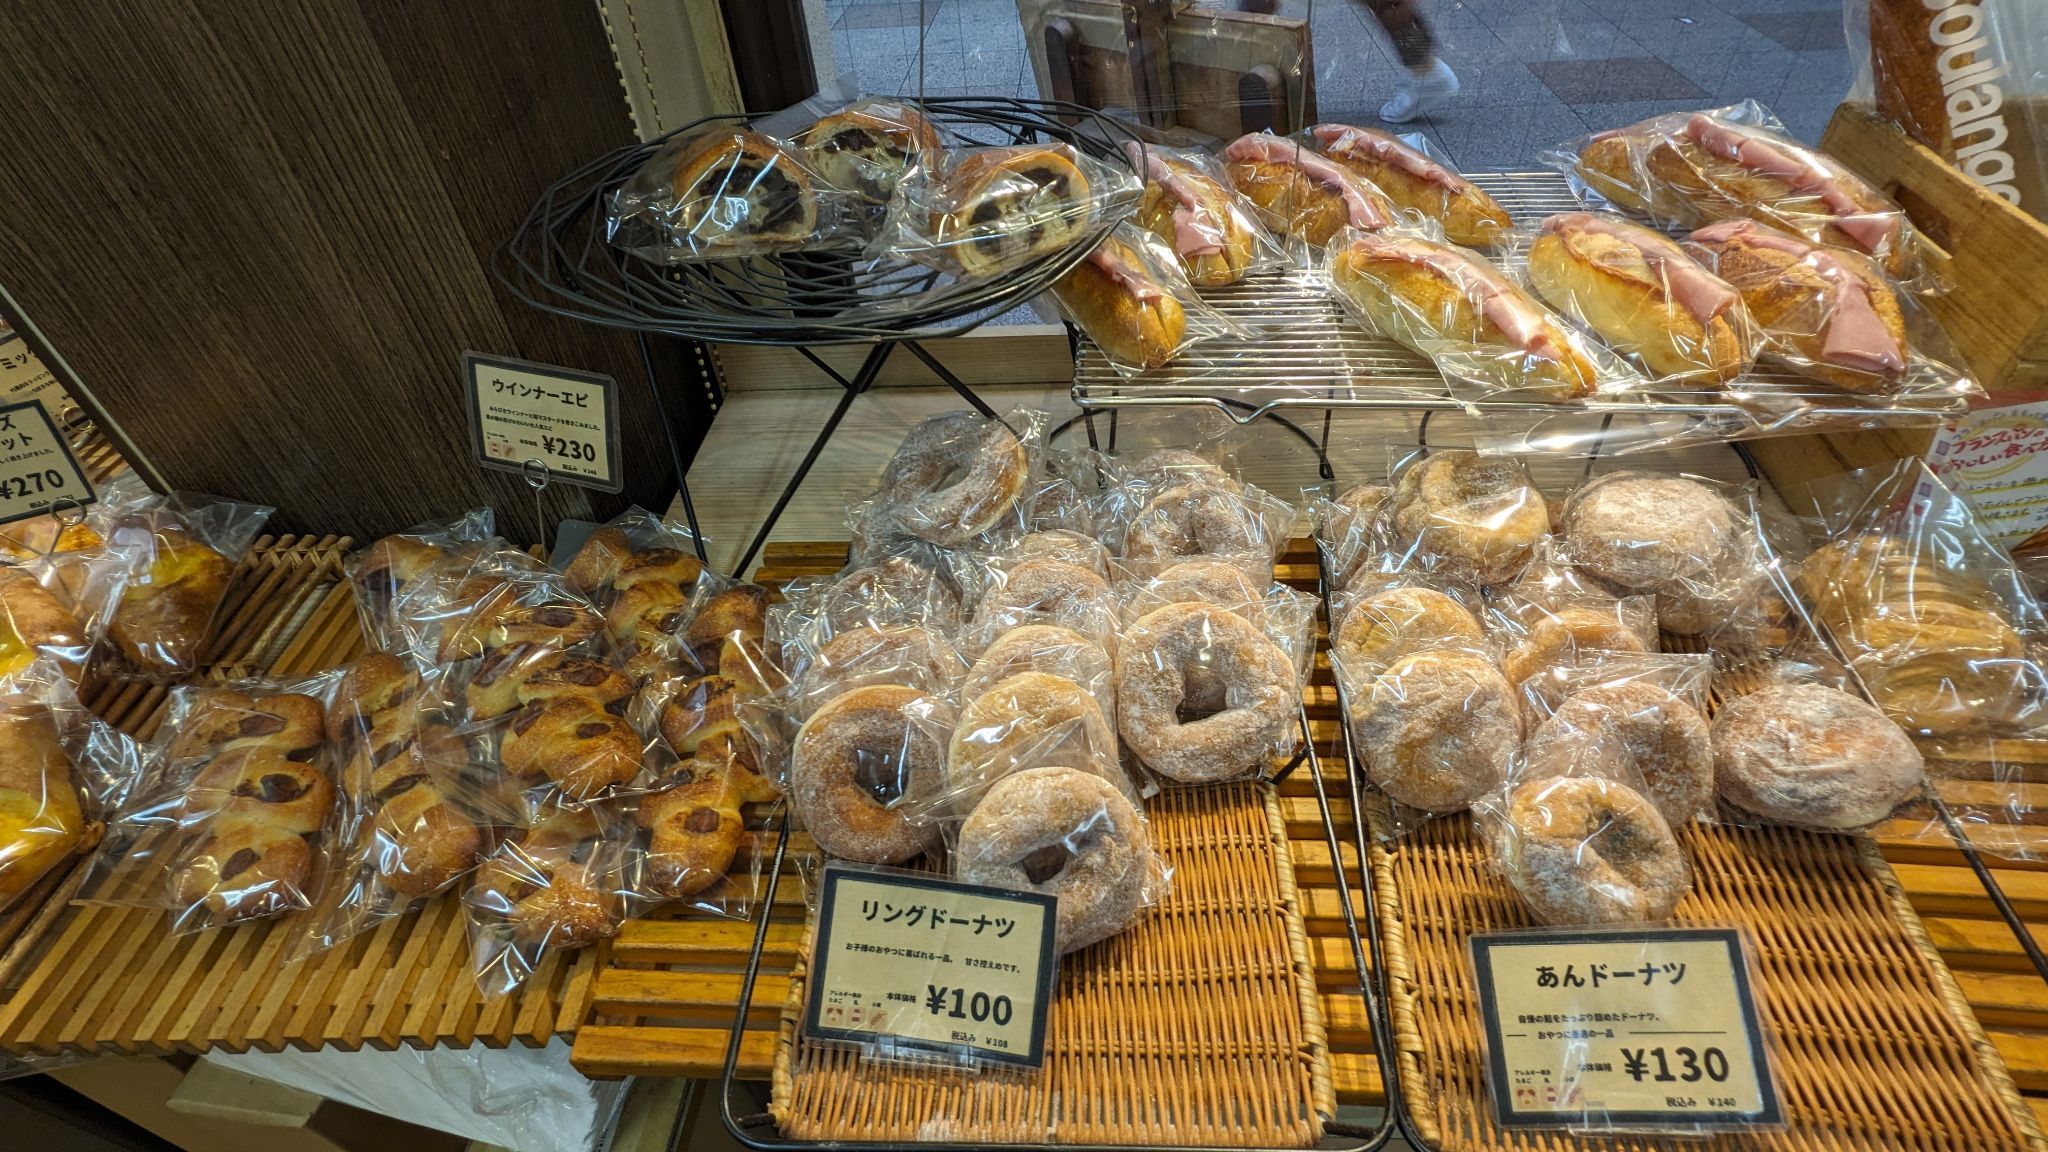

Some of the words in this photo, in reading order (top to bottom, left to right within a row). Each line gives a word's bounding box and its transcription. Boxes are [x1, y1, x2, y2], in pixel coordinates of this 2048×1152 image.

[1922, 0, 2021, 207] oulang
[0, 345, 39, 370] ミッ
[492, 378, 589, 408] ウインナーエピ
[541, 435, 596, 463] ¥230
[0, 469, 64, 500] ¥270
[862, 900, 1015, 939] リングドーナツ
[845, 942, 953, 963] お子様のおやつに喜ばれる一品。
[965, 956, 1021, 974] 甘さ控えめです。
[1535, 962, 1687, 988] あんドーナツ
[886, 991, 917, 1004] 本体価格
[925, 984, 1013, 1026] ¥100
[951, 1030, 976, 1043] 税込み
[985, 1035, 1008, 1048] ¥108
[1620, 1046, 1729, 1083] ¥130
[1665, 1096, 1697, 1109] 税込み
